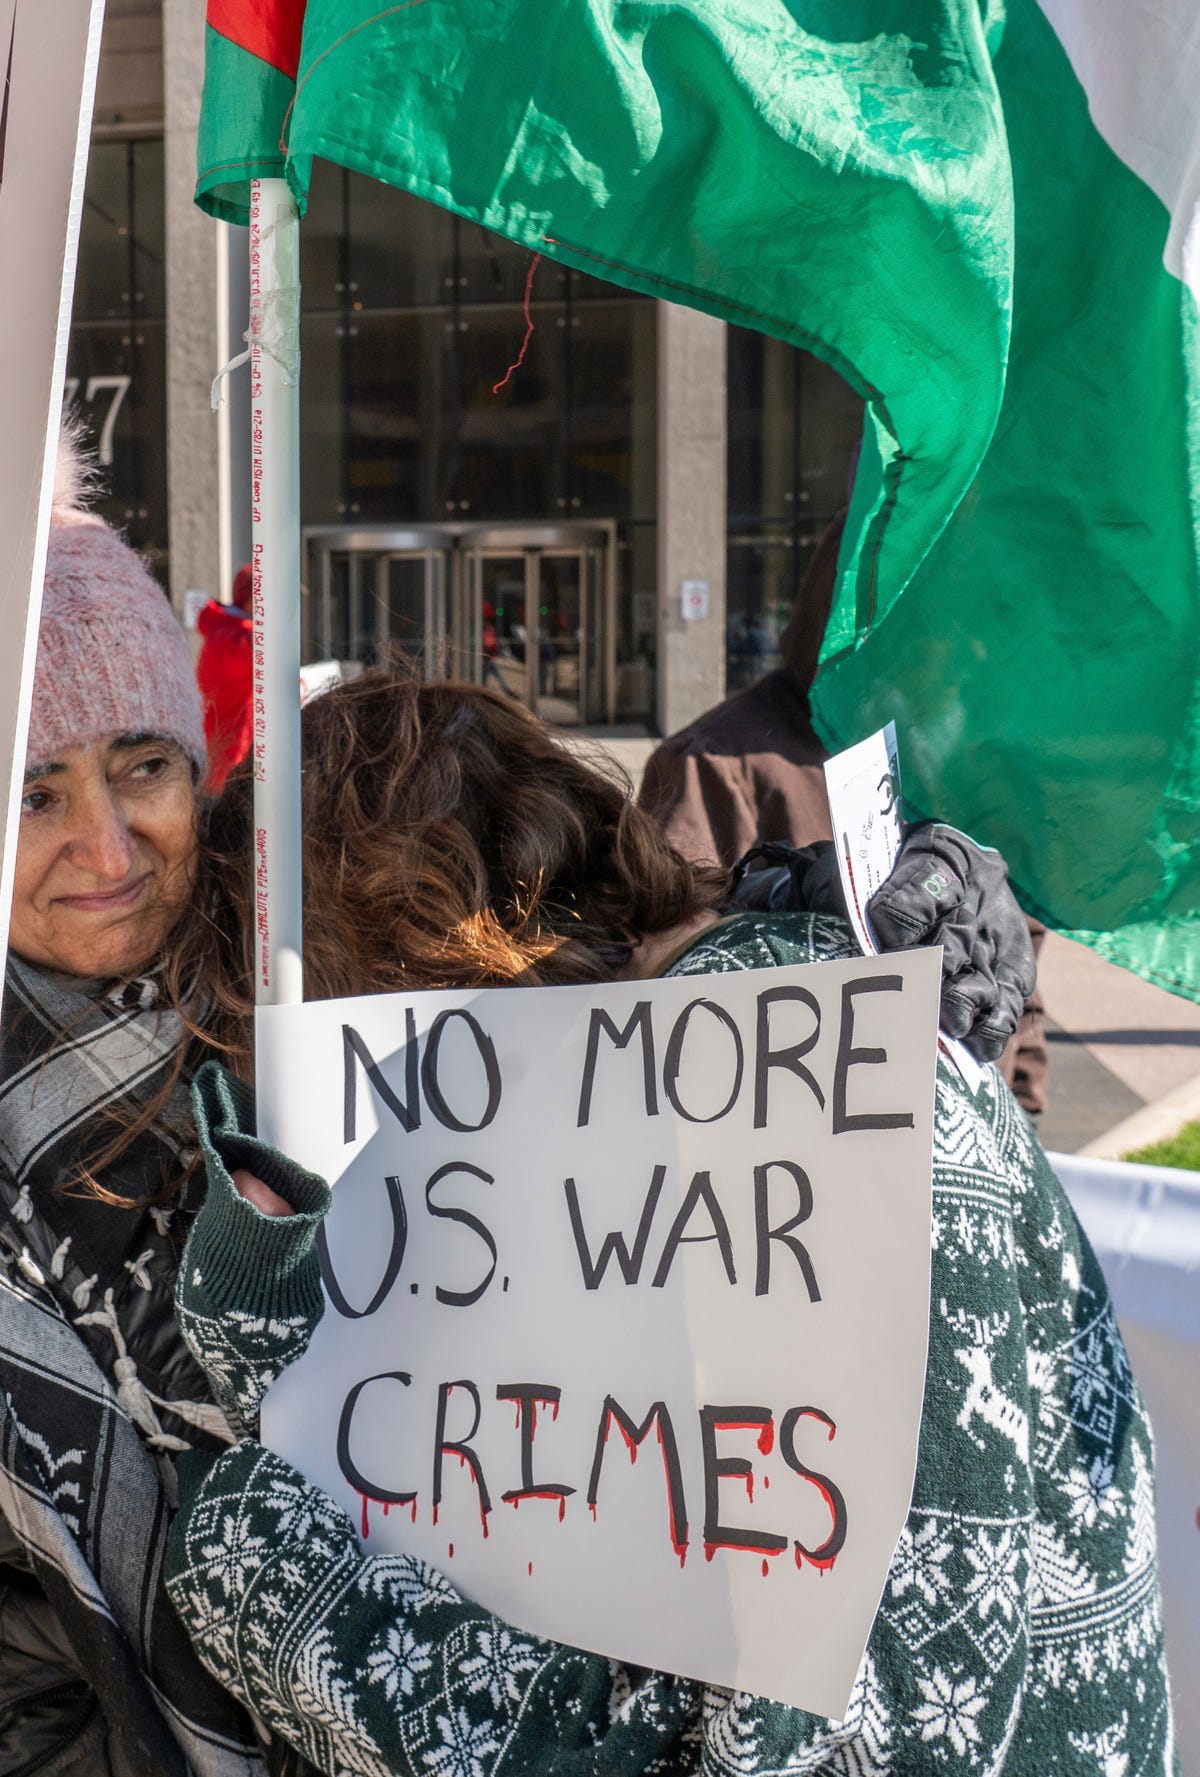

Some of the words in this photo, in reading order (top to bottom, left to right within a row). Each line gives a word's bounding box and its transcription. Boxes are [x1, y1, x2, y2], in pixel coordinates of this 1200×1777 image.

[252, 458, 264, 480] ASTM
[253, 631, 265, 647] PSI
[254, 650, 265, 666] 600
[254, 669, 265, 681] PR
[254, 684, 265, 694] 40
[255, 718, 266, 738] 1120
[255, 743, 266, 759] PVC
[256, 868, 268, 888] PIPE
[256, 891, 269, 935] CHARLOTTE
[341, 1006, 502, 1144] NO
[576, 975, 915, 1135] MORE
[318, 1160, 510, 1320] U.S.
[564, 1160, 822, 1304] WAR
[337, 1370, 848, 1569] CRIMES
